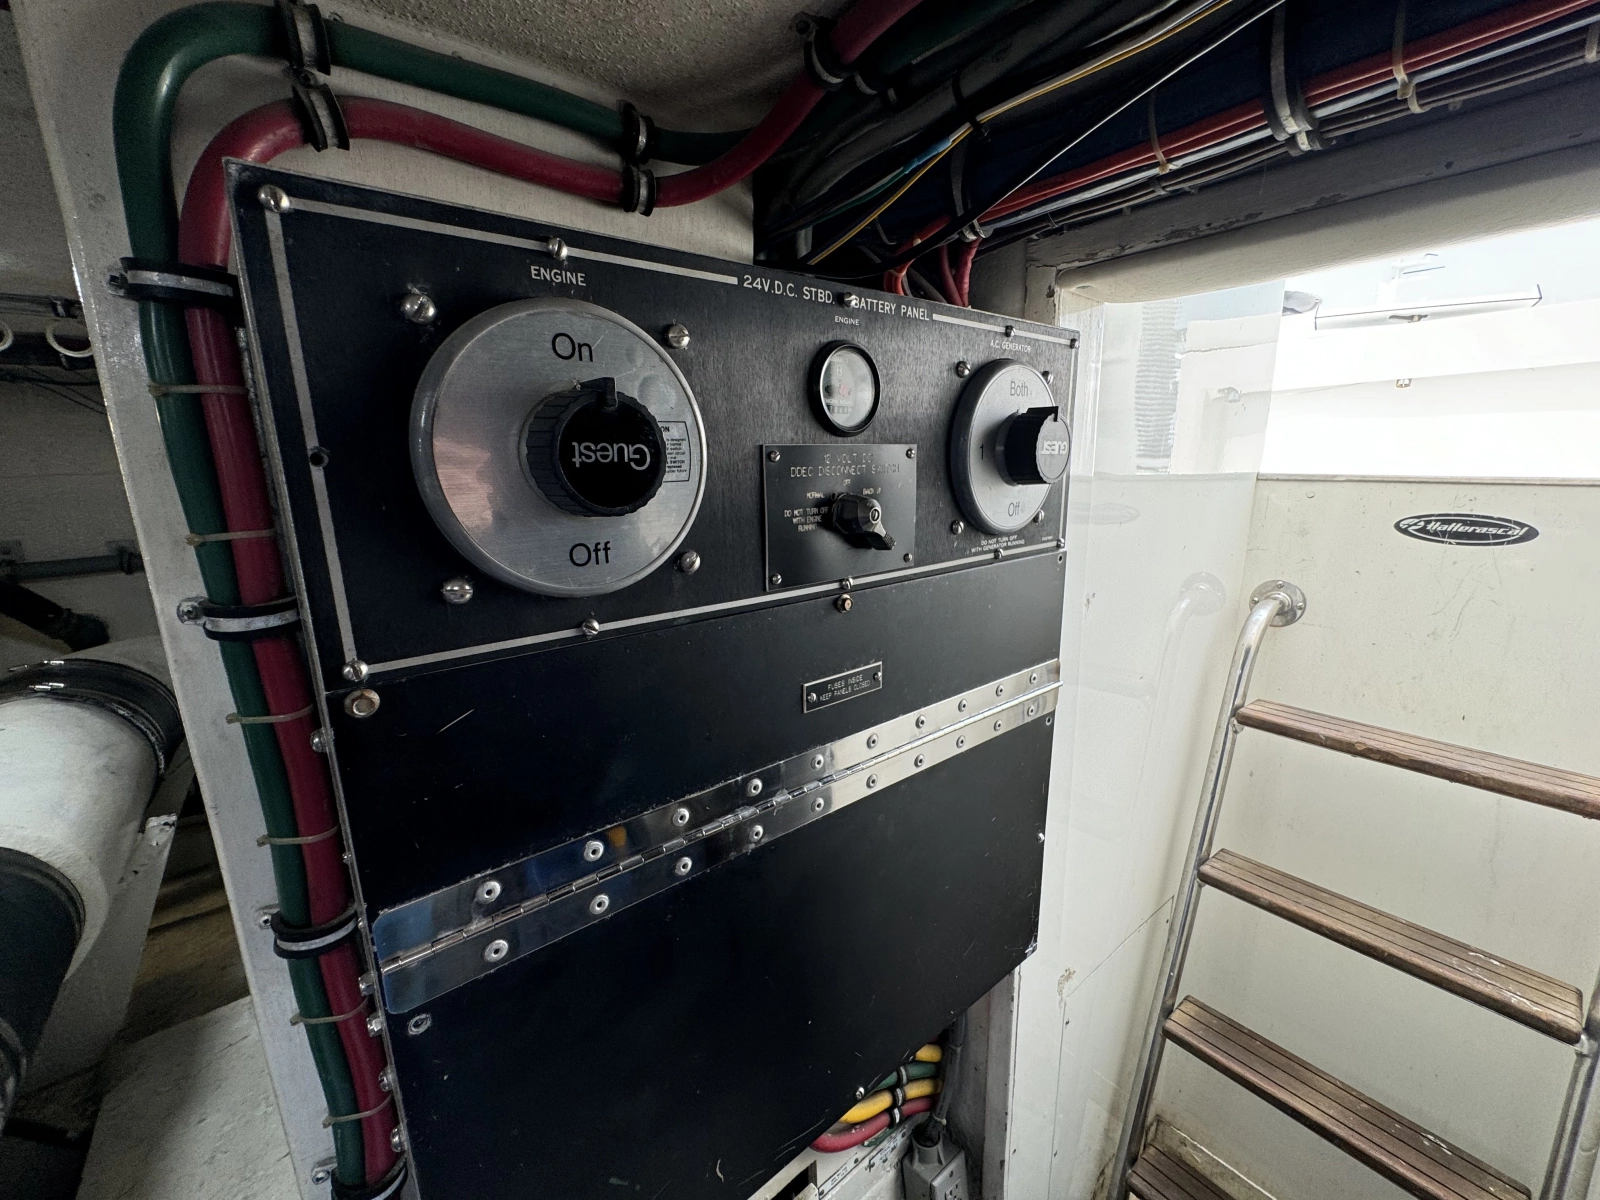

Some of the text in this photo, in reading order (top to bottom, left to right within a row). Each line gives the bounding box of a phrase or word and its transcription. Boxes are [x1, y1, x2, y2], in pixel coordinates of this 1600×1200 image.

[530, 265, 587, 286] ENGINE
[743, 275, 929, 321] 24V.D.C. STBD. BATTERY PANEL
[834, 315, 859, 325] ENGINE
[551, 332, 594, 362] On
[1001, 341, 1032, 353] GENERATOR
[1010, 380, 1029, 397] Both
[979, 443, 984, 460] 1
[1041, 440, 1068, 455] GUEST
[571, 441, 650, 471] Guest
[824, 453, 832, 464] 12
[837, 453, 858, 464] VOLT
[790, 466, 814, 478] DDEC
[818, 464, 867, 477] DISCONNECT
[794, 508, 804, 516] NOT
[805, 507, 819, 515] TURN
[820, 506, 828, 514] OFF
[1007, 502, 1021, 518] Off
[792, 515, 822, 525] WITH ENGINE
[569, 541, 612, 567] Off
[820, 680, 870, 701] KEEP PANELS CLOSED
[828, 675, 863, 690] FUSES INSIDE
